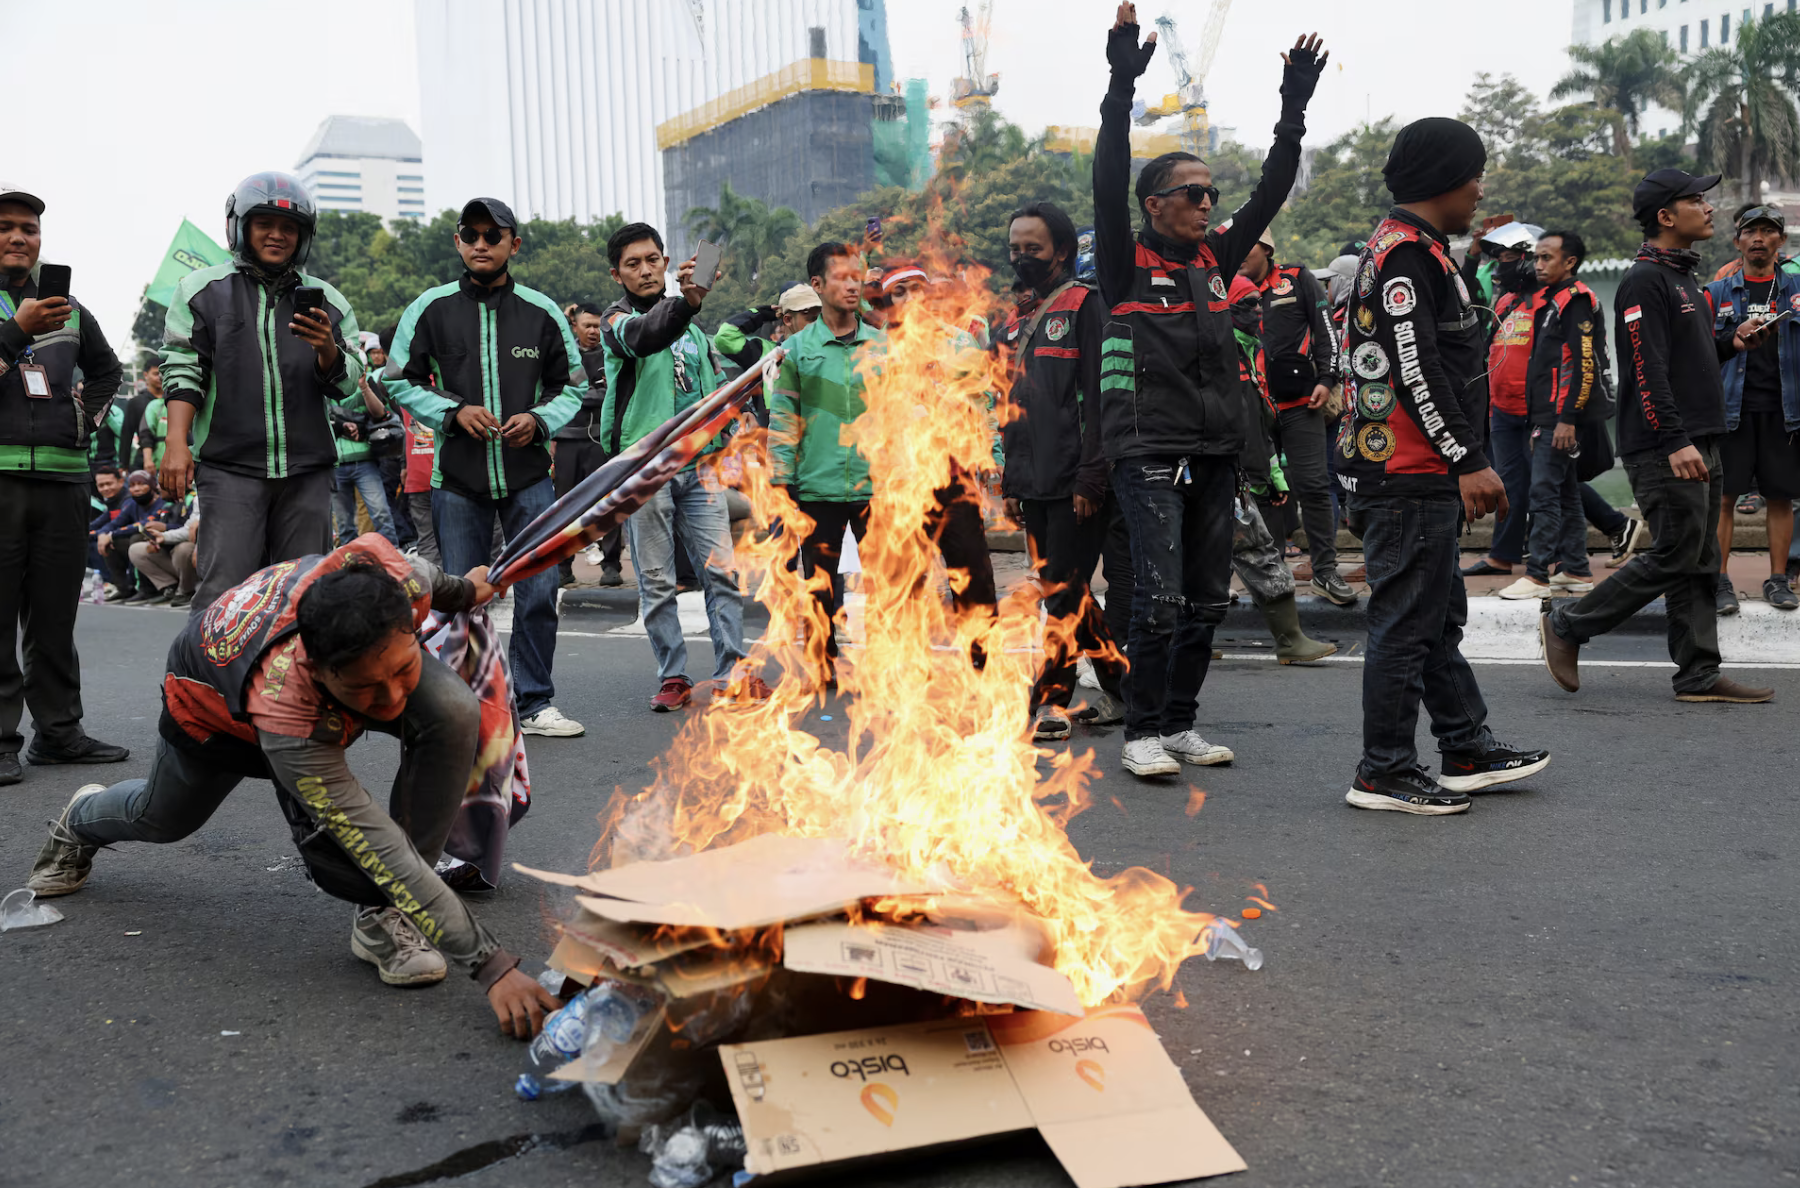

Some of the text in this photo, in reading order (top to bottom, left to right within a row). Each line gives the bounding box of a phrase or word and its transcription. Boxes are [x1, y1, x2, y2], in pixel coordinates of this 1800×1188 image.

[1574, 335, 1594, 408] JAKARTA SELATAN
[1628, 320, 1661, 430] Sahabat Arion
[1417, 401, 1446, 438] OJOL
[1048, 1036, 1110, 1057] bisto
[830, 1053, 910, 1081] bisto
